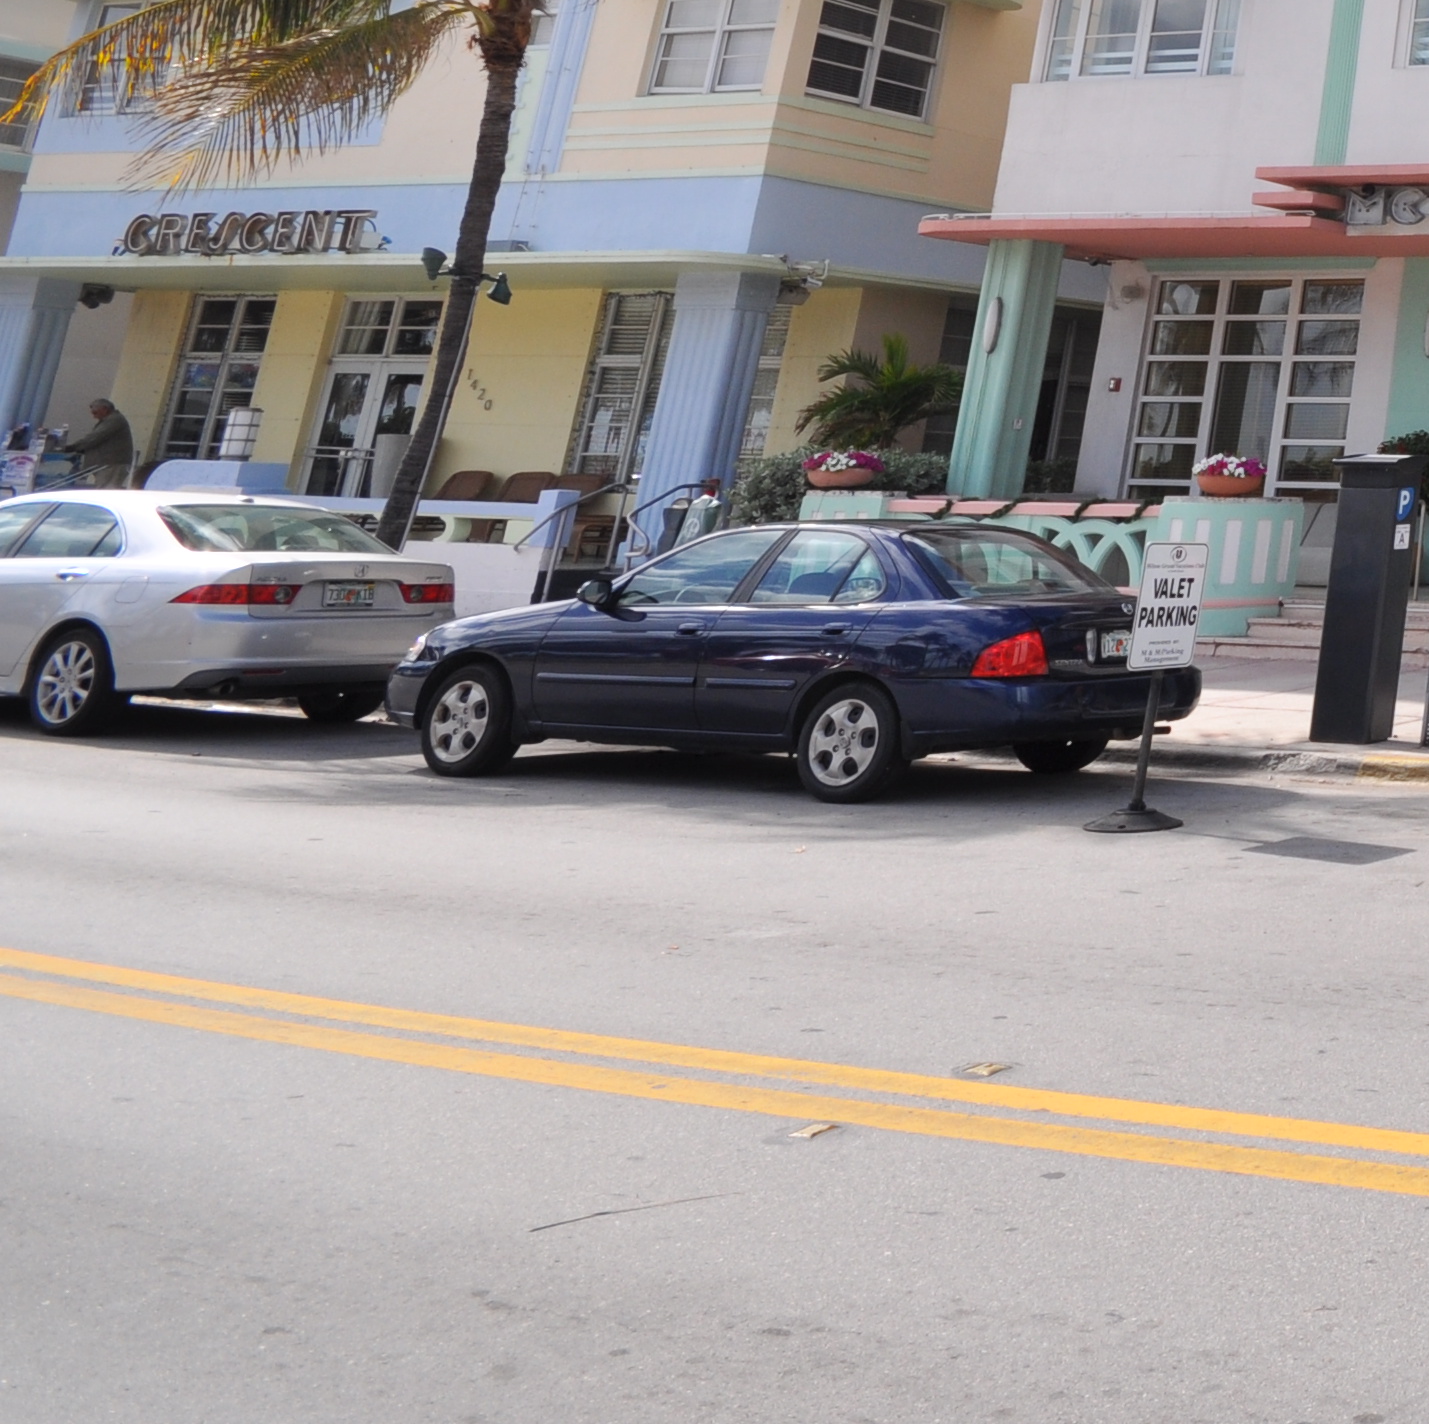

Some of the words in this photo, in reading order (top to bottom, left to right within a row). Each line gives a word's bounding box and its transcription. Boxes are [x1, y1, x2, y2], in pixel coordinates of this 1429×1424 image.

[124, 210, 378, 254] CRESCENT
[467, 368, 493, 411] 1420
[1399, 490, 1410, 514] P
[1154, 578, 1195, 599] VALET
[1138, 605, 1197, 628] PARKING
